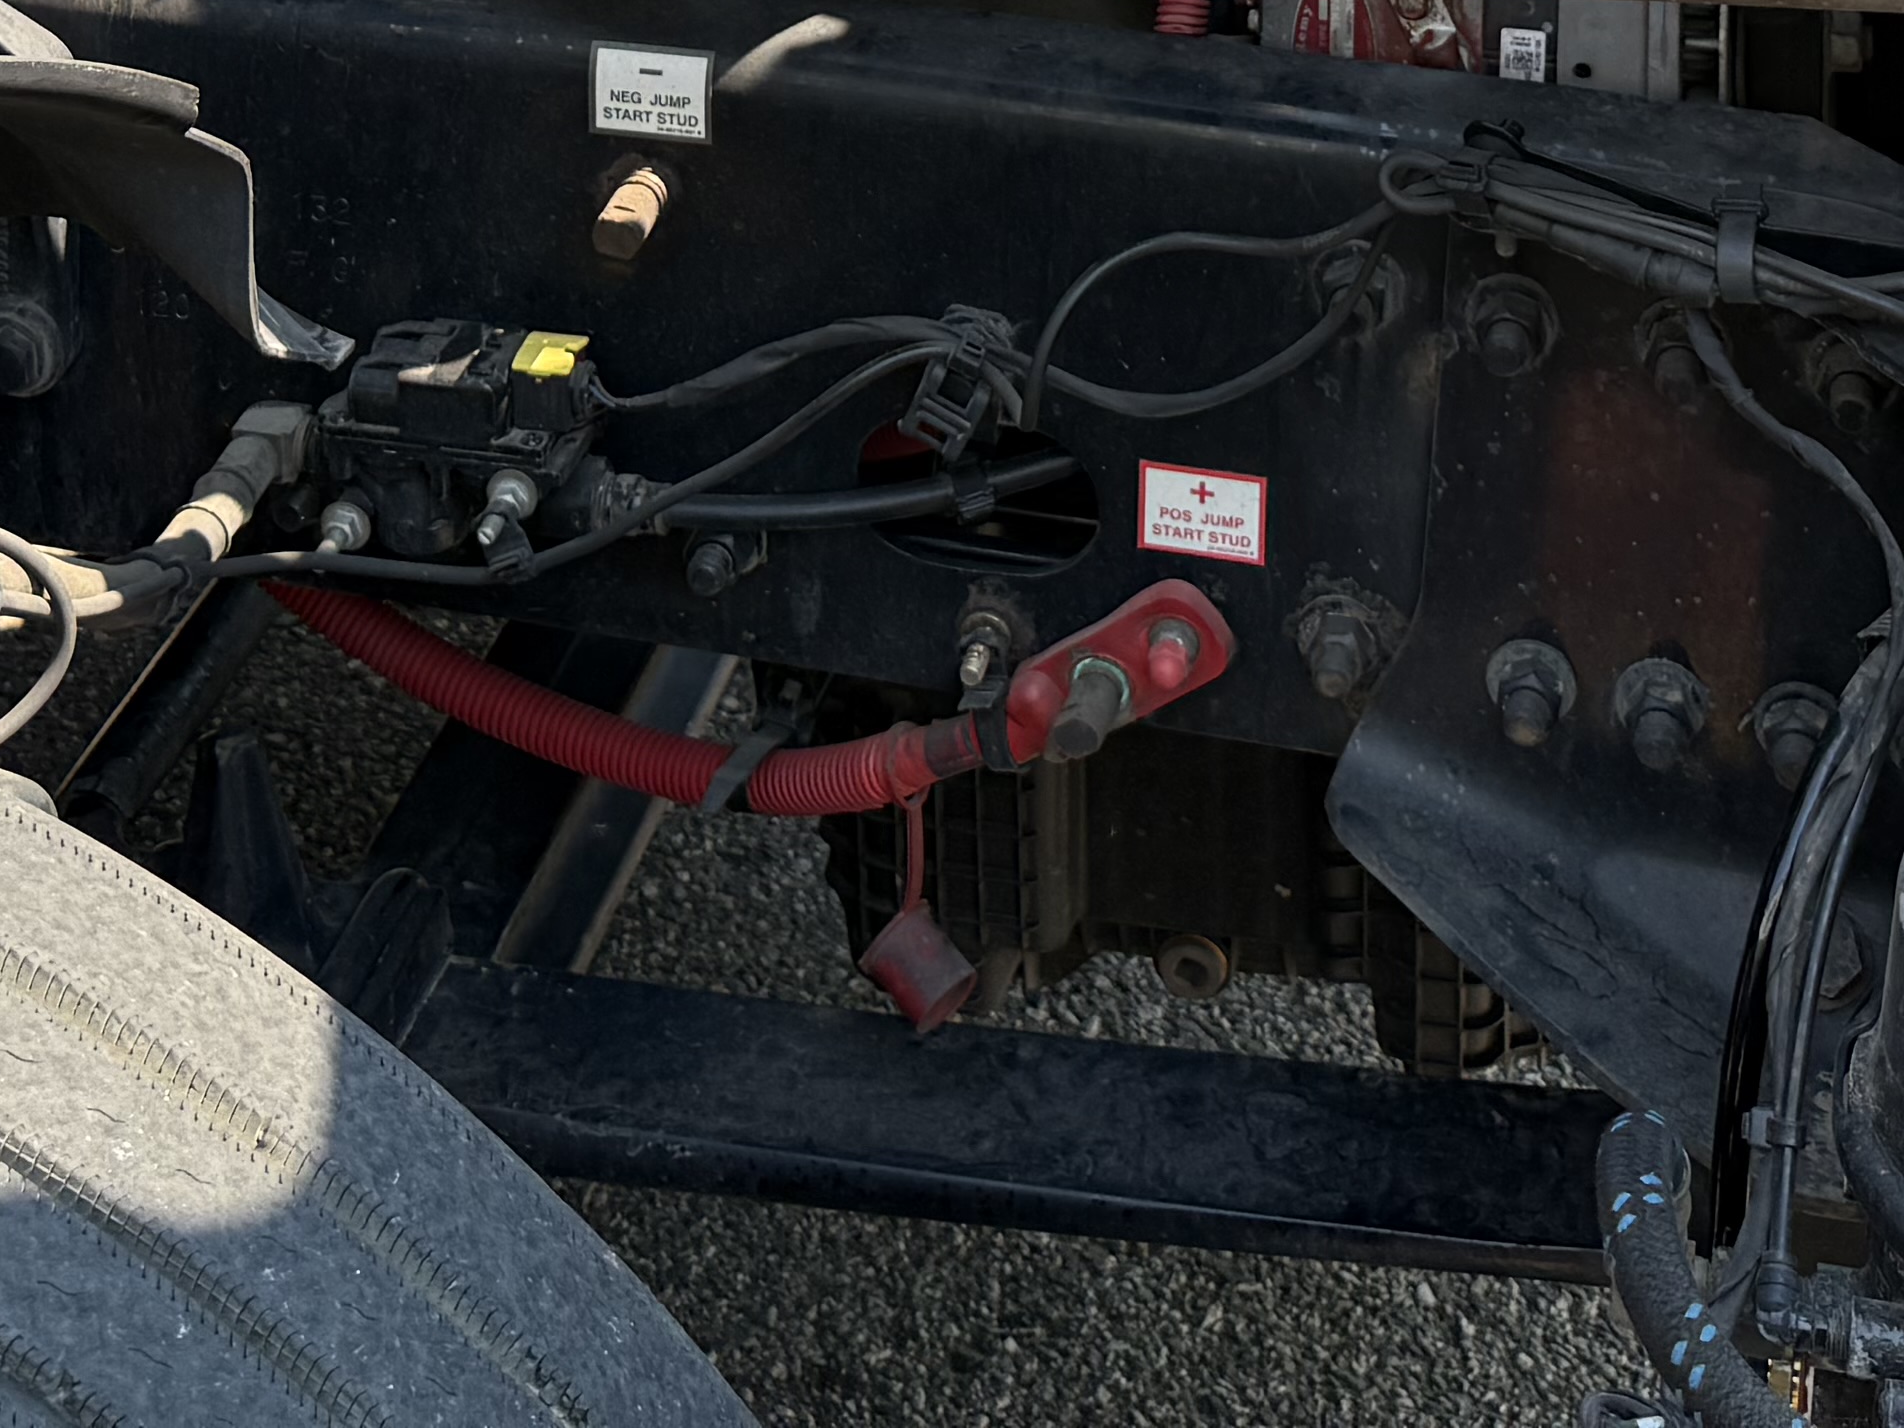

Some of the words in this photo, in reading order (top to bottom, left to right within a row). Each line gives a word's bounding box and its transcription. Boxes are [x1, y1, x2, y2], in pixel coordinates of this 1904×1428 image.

[609, 89, 642, 105] NEG
[649, 93, 692, 110] JUMP
[602, 106, 653, 124] START
[657, 112, 700, 128] STUD
[1159, 505, 1193, 523] POS
[1200, 512, 1246, 530] JUMP
[1152, 522, 1205, 542] START
[1208, 532, 1252, 549] STUD
